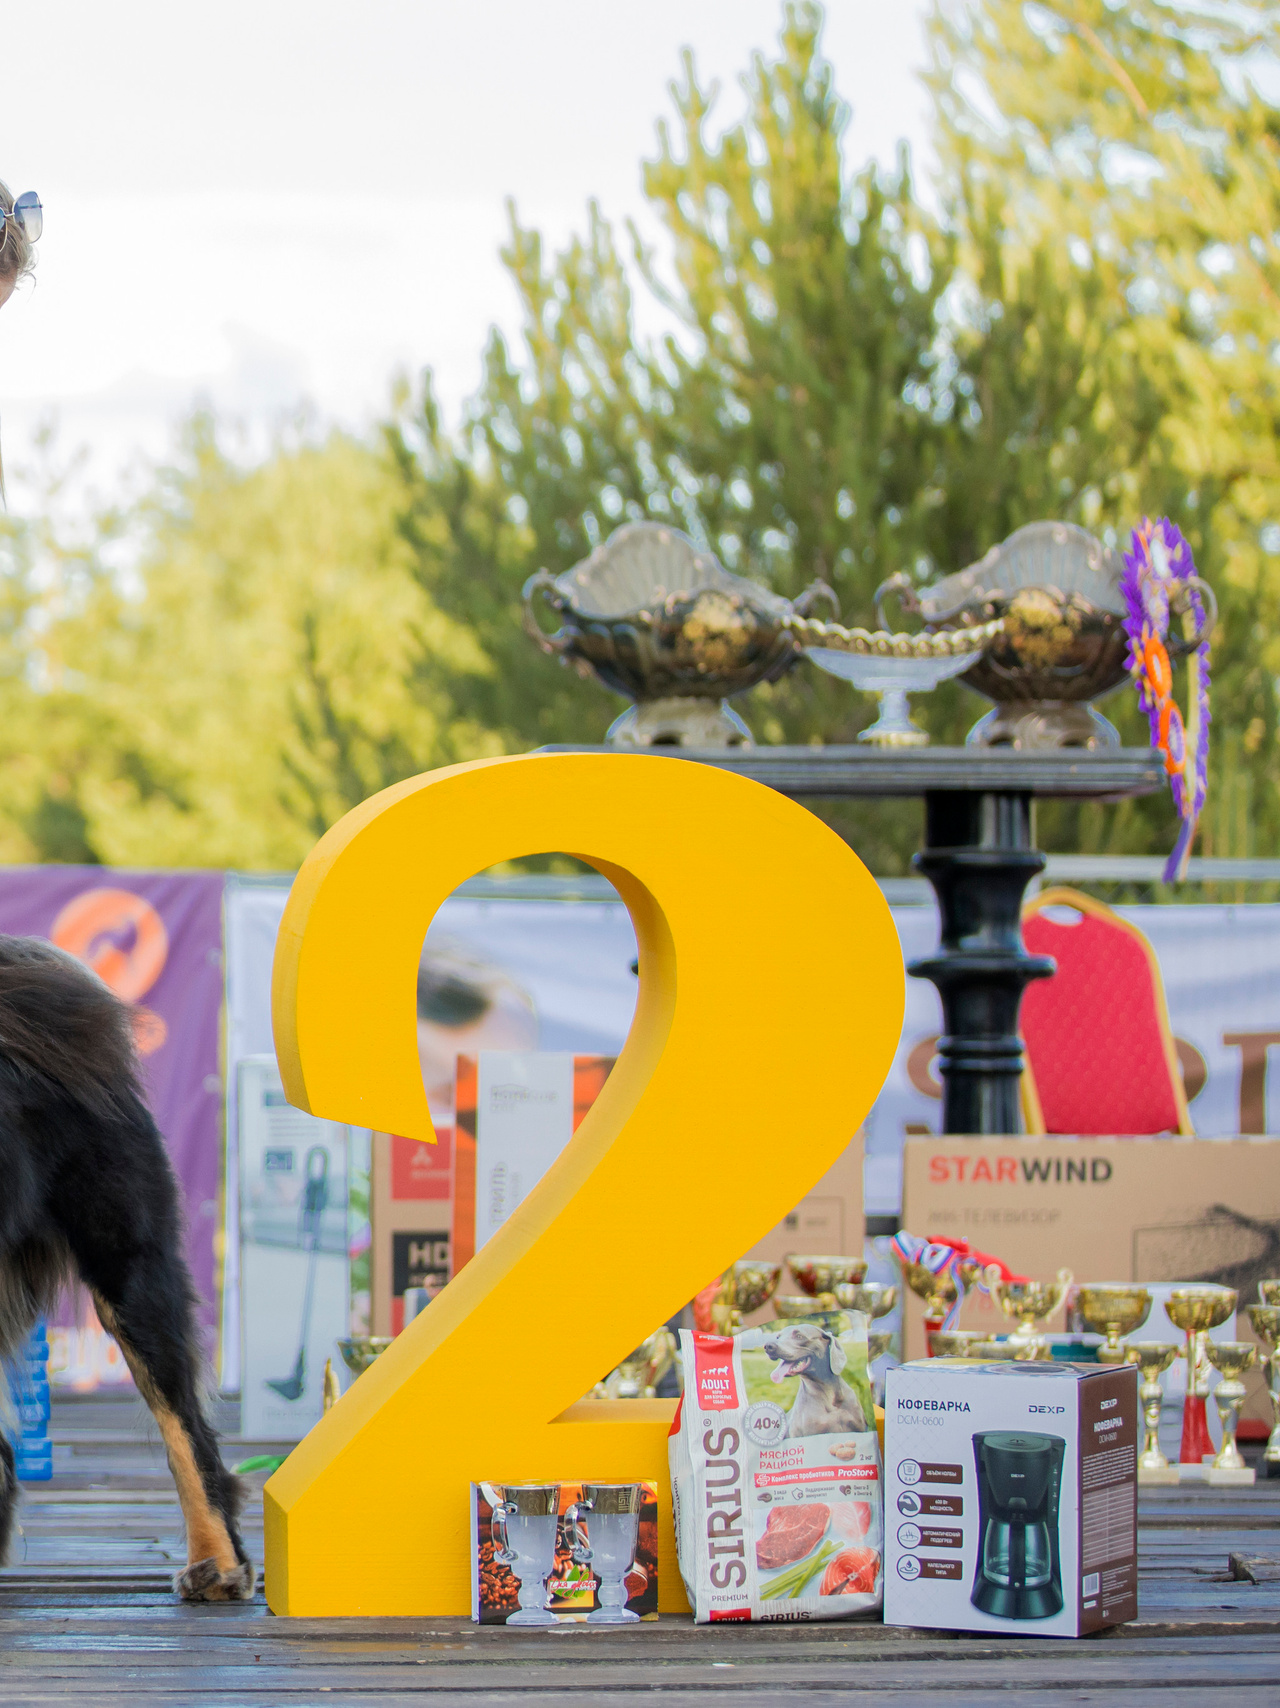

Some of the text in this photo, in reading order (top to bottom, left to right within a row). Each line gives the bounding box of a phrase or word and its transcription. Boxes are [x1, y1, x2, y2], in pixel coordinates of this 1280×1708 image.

[701, 1379, 730, 1390] ADULT
[897, 1399, 971, 1412] КОФЕВАРКА
[1028, 1405, 1066, 1414] DEXP
[1100, 1398, 1118, 1410] DEXP
[753, 1417, 781, 1430] 40%
[897, 1415, 944, 1426] DCM-0600
[1093, 1416, 1124, 1432] КОФЕВАРКА
[759, 1445, 805, 1459] МЯСНОЙ
[759, 1457, 803, 1469] РАЦИОН
[771, 1470, 835, 1483] Комплекс пробиотиков
[838, 1469, 874, 1477] ProStor+
[703, 1427, 747, 1589] SIRIUS
